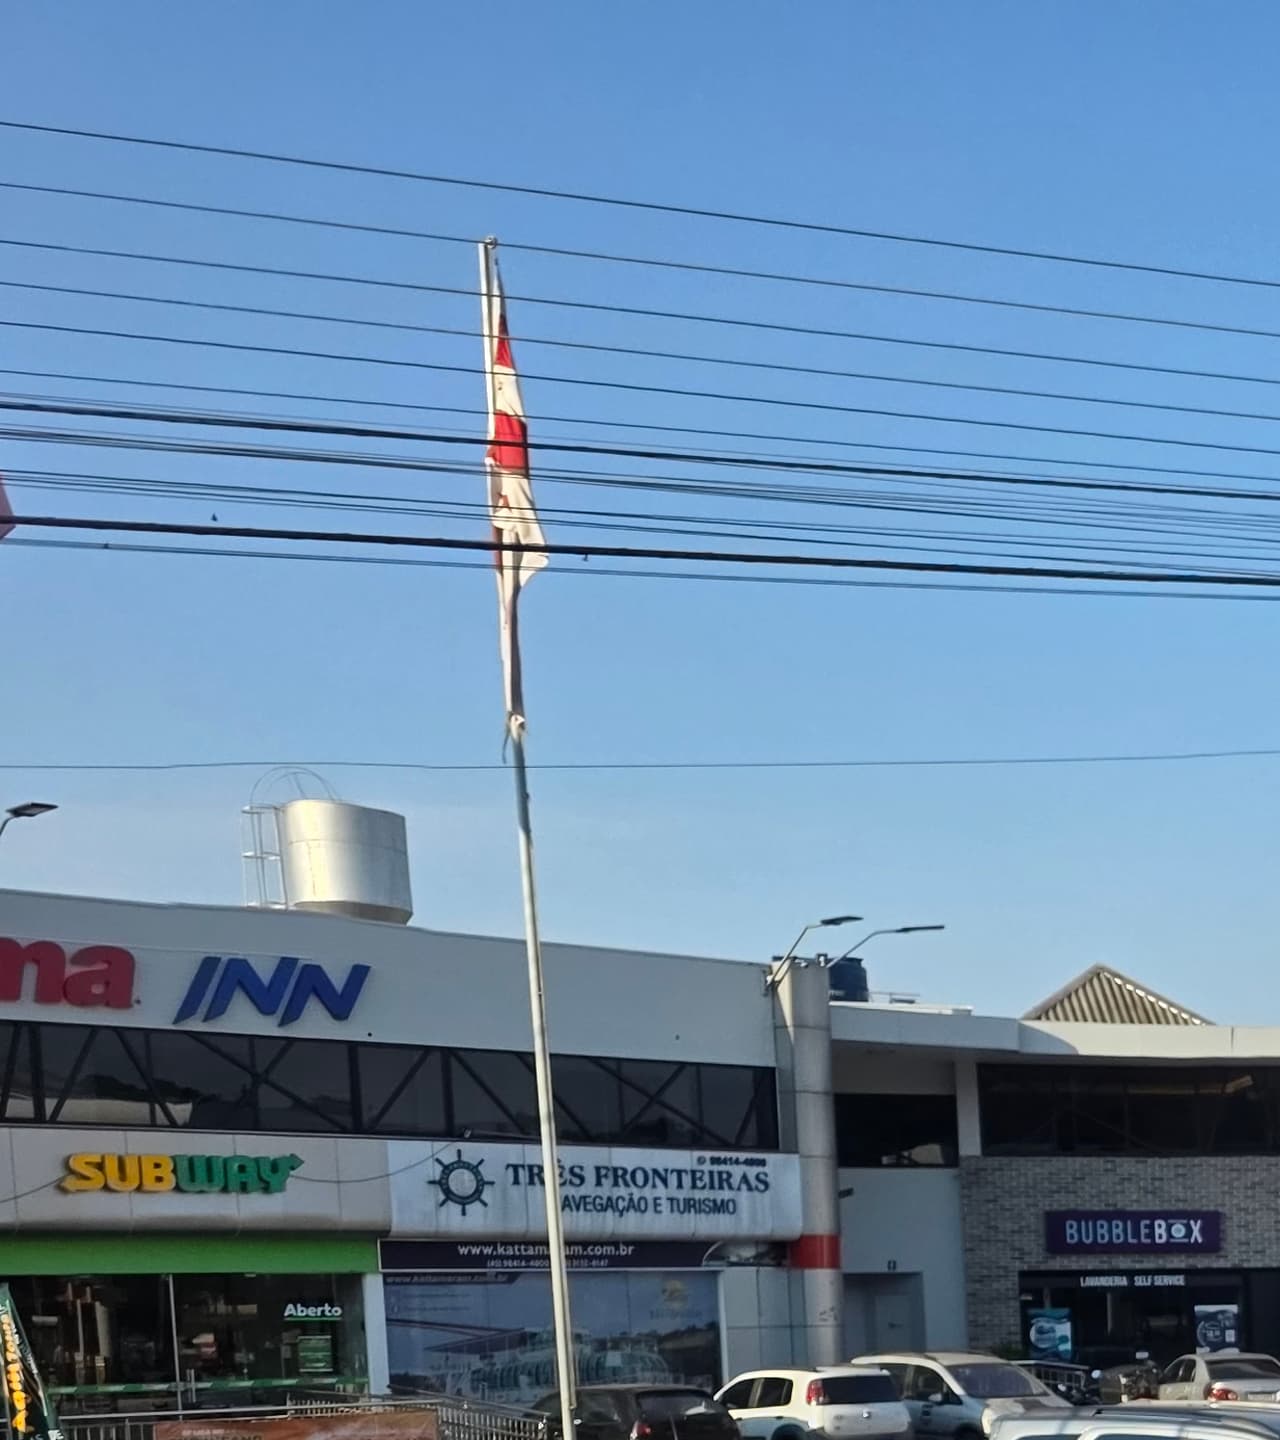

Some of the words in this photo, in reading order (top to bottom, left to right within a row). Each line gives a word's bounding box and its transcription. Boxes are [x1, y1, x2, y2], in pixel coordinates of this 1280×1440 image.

[173, 957, 371, 1027] INN
[60, 1153, 304, 1193] SUBWAY
[594, 1165, 770, 1193] FRONTEIRAS
[561, 1193, 648, 1217] AVEGAÇÃO
[653, 1197, 662, 1213] E
[666, 1197, 737, 1214] TURISMO
[1065, 1219, 1203, 1244] BUBBLEBOX
[458, 1242, 635, 1256] www.kattamm.com.br
[1134, 1275, 1153, 1287] SELF
[1154, 1274, 1186, 1287] SERVICE
[284, 1303, 342, 1316] Aberto
